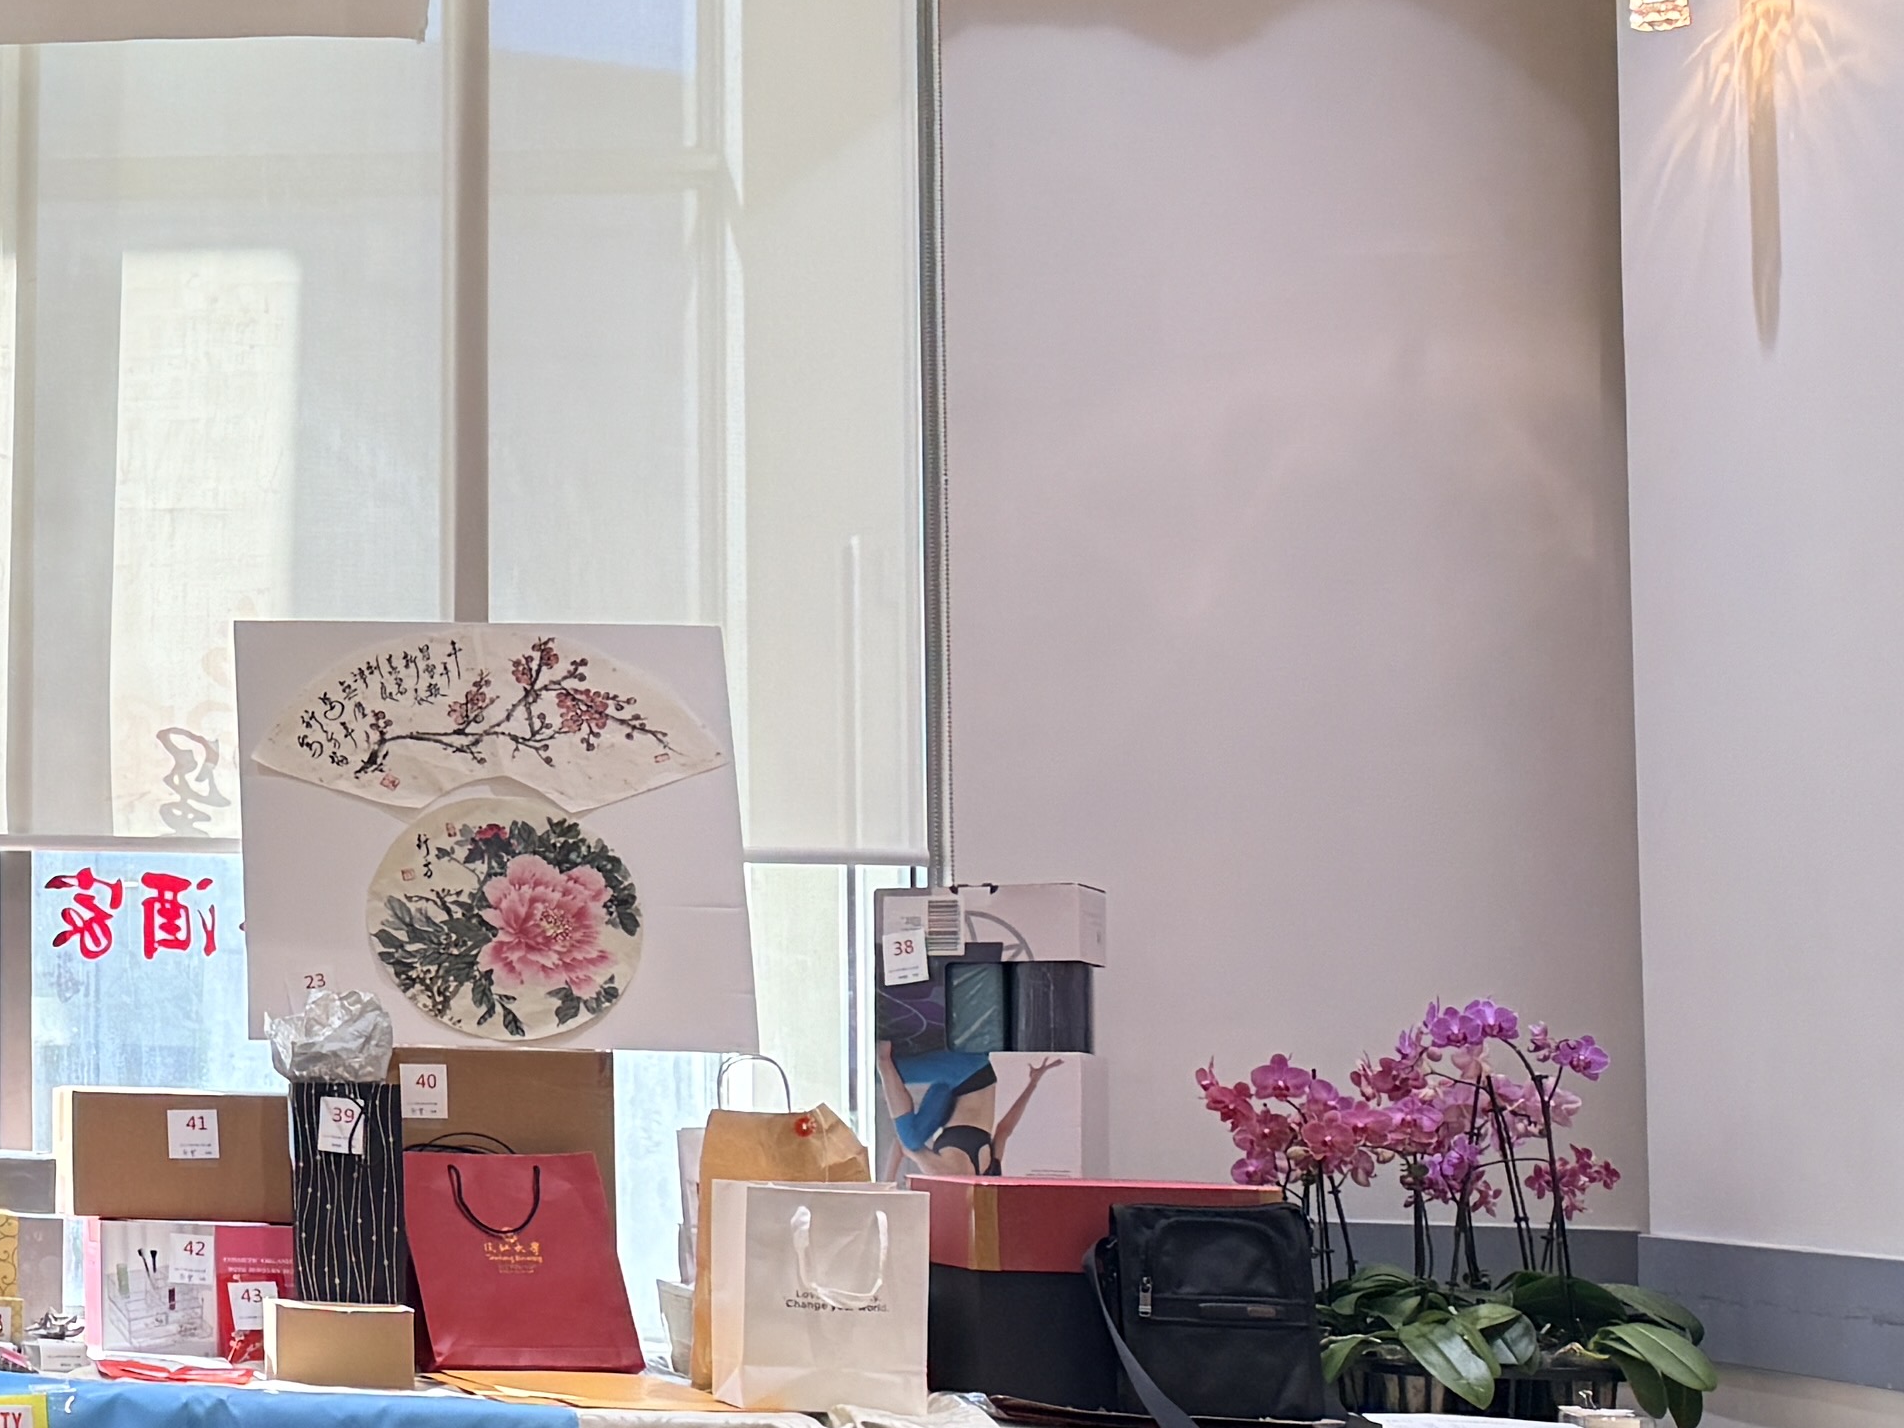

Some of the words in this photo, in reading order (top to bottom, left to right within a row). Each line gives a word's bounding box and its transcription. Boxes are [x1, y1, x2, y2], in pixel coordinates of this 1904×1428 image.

[893, 939, 914, 956] 38
[304, 974, 326, 990] 23
[415, 1073, 437, 1089] 40
[331, 1107, 354, 1125] 39
[184, 1118, 208, 1133] 41
[183, 1241, 205, 1256] 42
[241, 1289, 263, 1303] 43
[785, 1299, 827, 1311] Change
